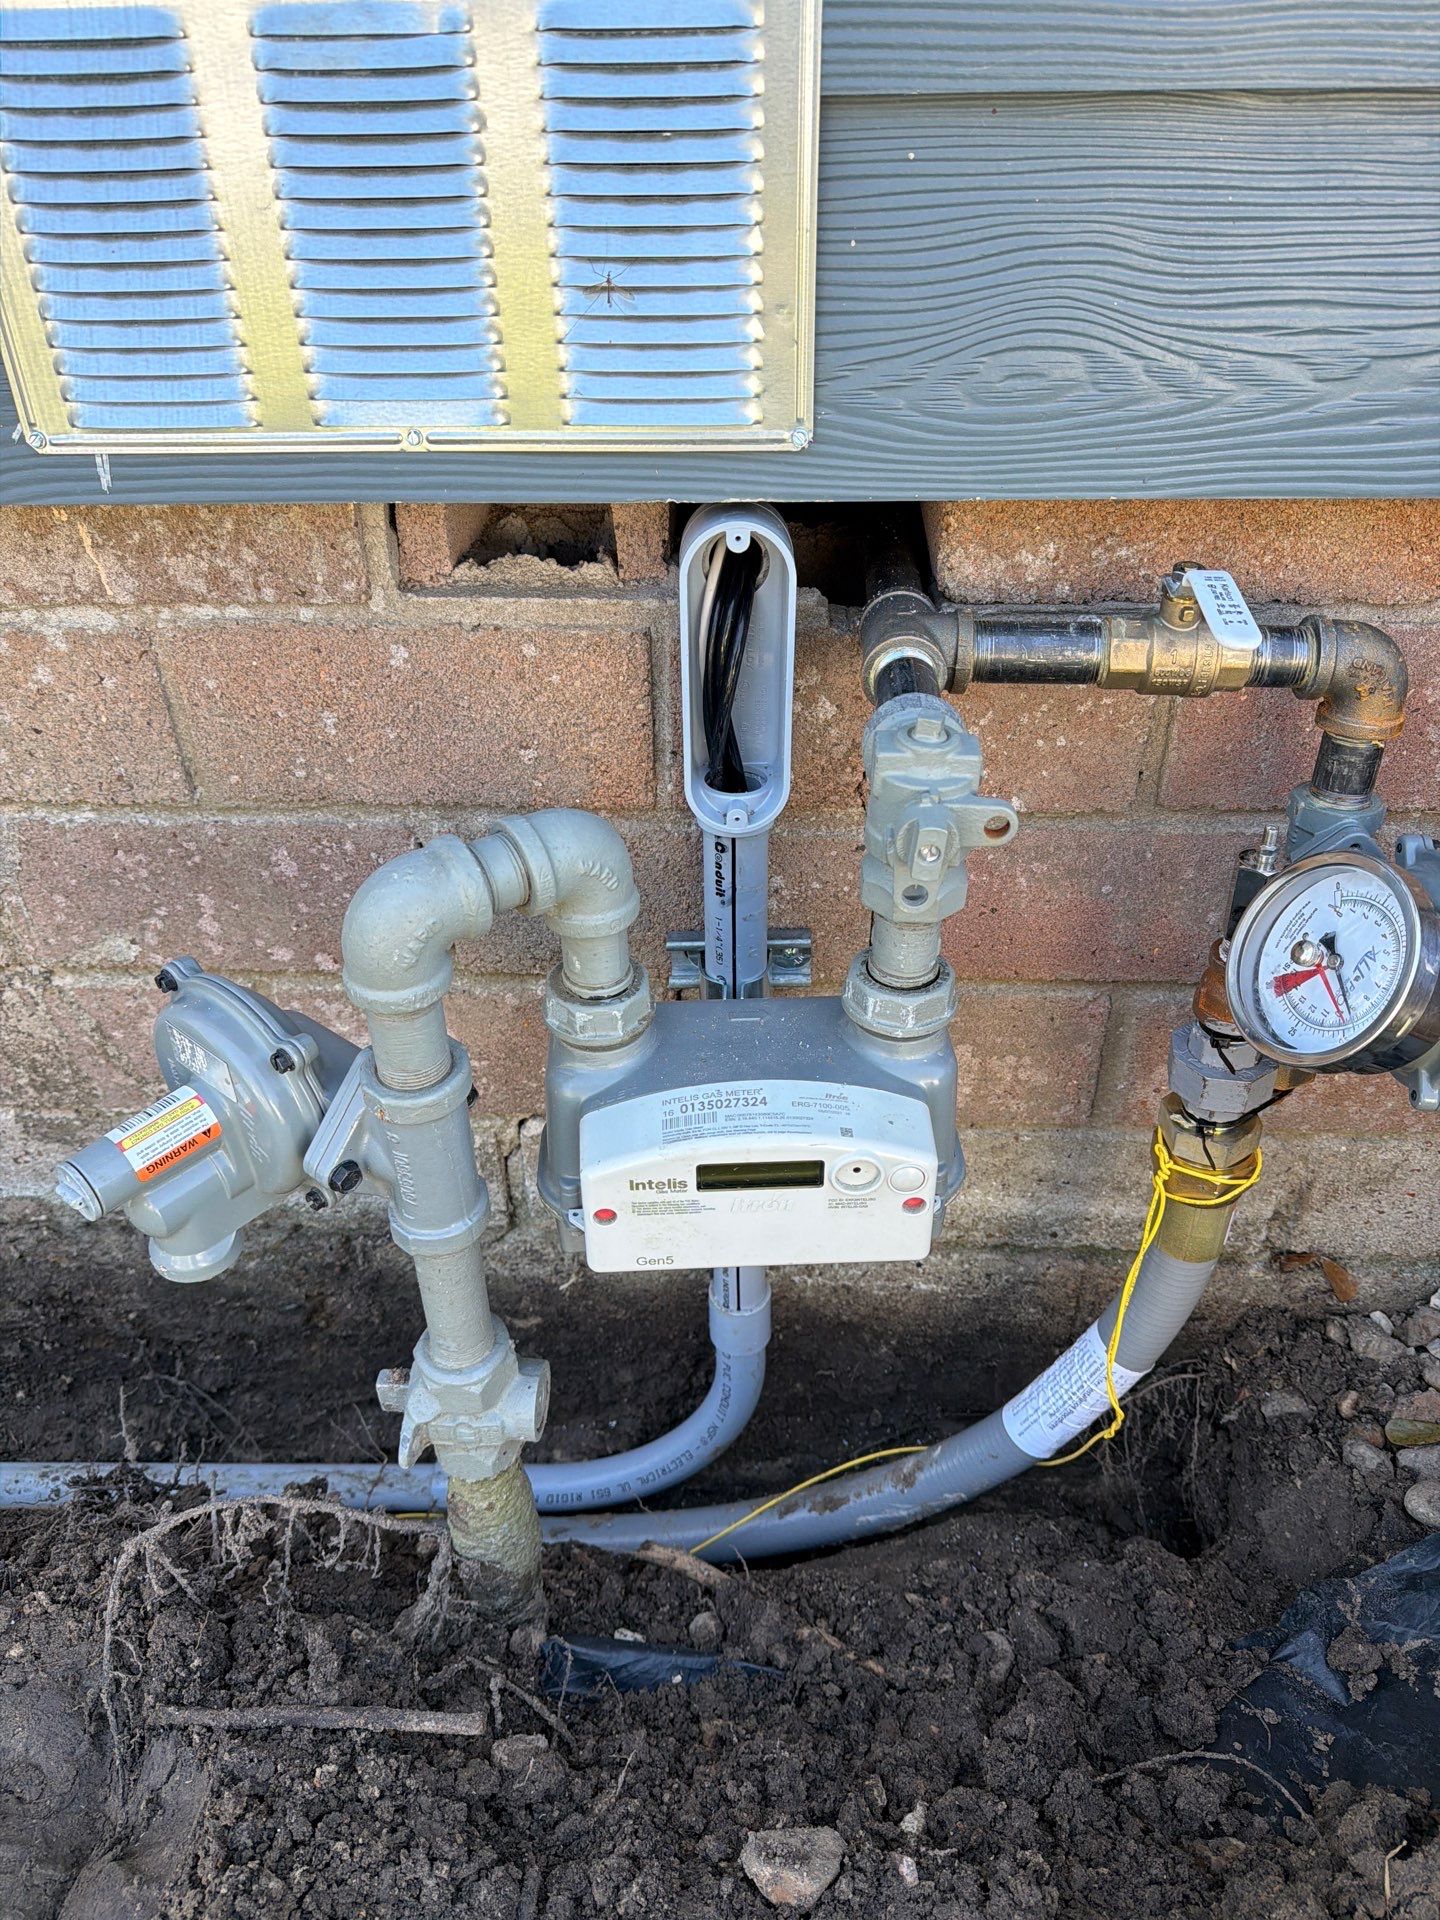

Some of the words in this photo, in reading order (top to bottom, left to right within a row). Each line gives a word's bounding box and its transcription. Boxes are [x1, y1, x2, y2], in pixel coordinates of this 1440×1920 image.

[1383, 948, 1391, 957] 5
[1298, 995, 1307, 1004] 13
[1363, 994, 1371, 1002] 8
[1308, 1004, 1317, 1013] 12
[1321, 1009, 1330, 1018] 11
[1287, 1026, 1298, 1037] 25
[661, 1094, 699, 1106] INTELIS
[702, 1090, 723, 1100] GAS
[663, 1110, 675, 1118] 16
[680, 1096, 768, 1114] 0135027324
[791, 1101, 850, 1111] ERG-7100-005
[145, 1137, 198, 1174] WARNING
[629, 1178, 688, 1191] Intelis
[636, 1255, 674, 1266] Gen5
[636, 1449, 694, 1486] ELECTRICAL
[616, 1481, 632, 1493] UL
[545, 1492, 583, 1505] RIGID
[591, 1486, 612, 1500] 651
